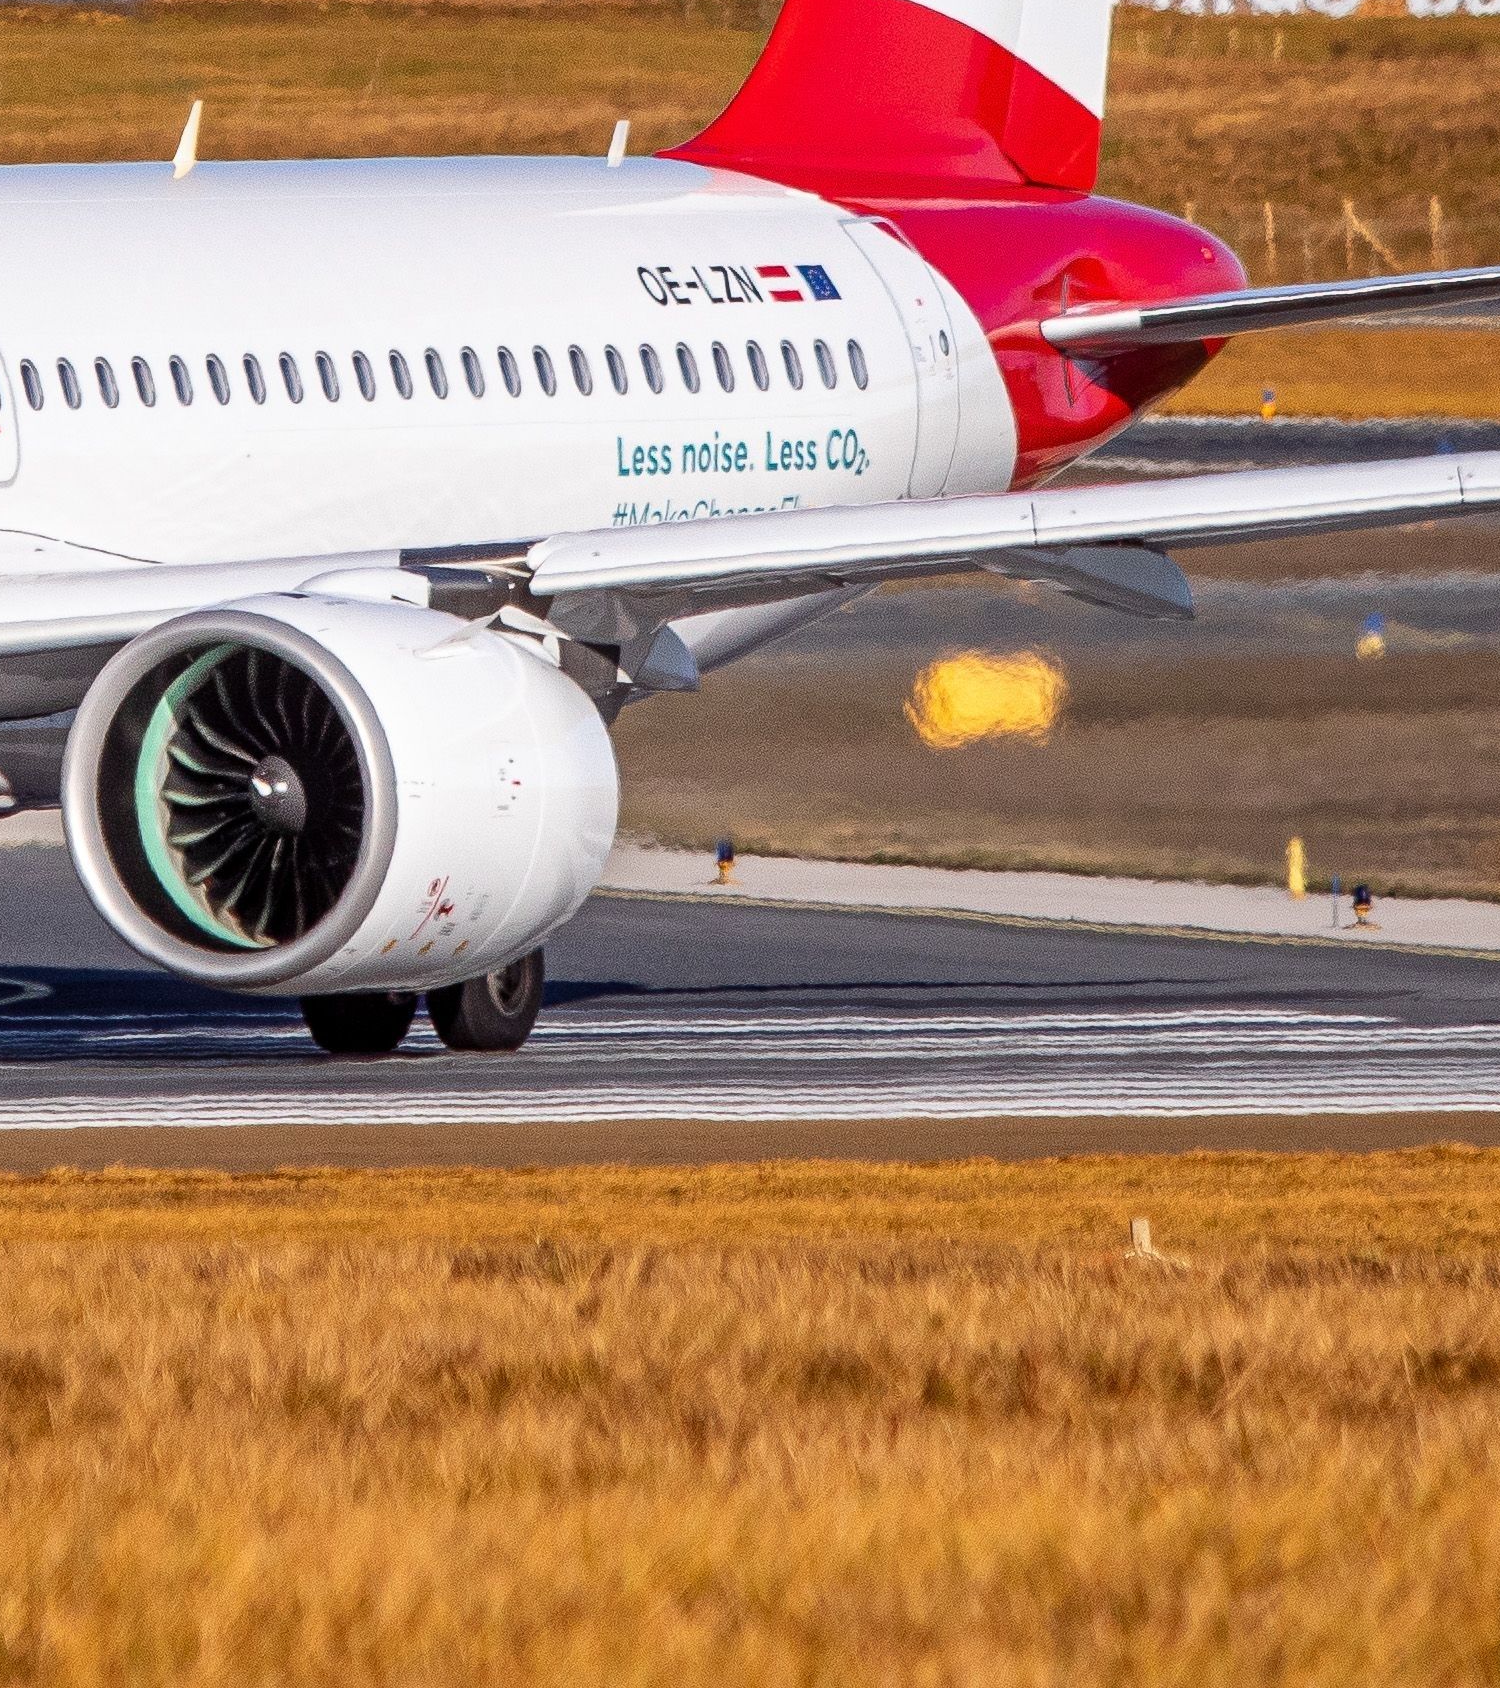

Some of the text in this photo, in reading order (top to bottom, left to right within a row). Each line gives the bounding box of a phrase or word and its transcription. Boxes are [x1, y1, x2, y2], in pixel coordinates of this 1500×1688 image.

[637, 265, 764, 306] OE-LZN
[617, 436, 671, 477] Less
[682, 431, 753, 475] noise.
[766, 431, 816, 472] Less
